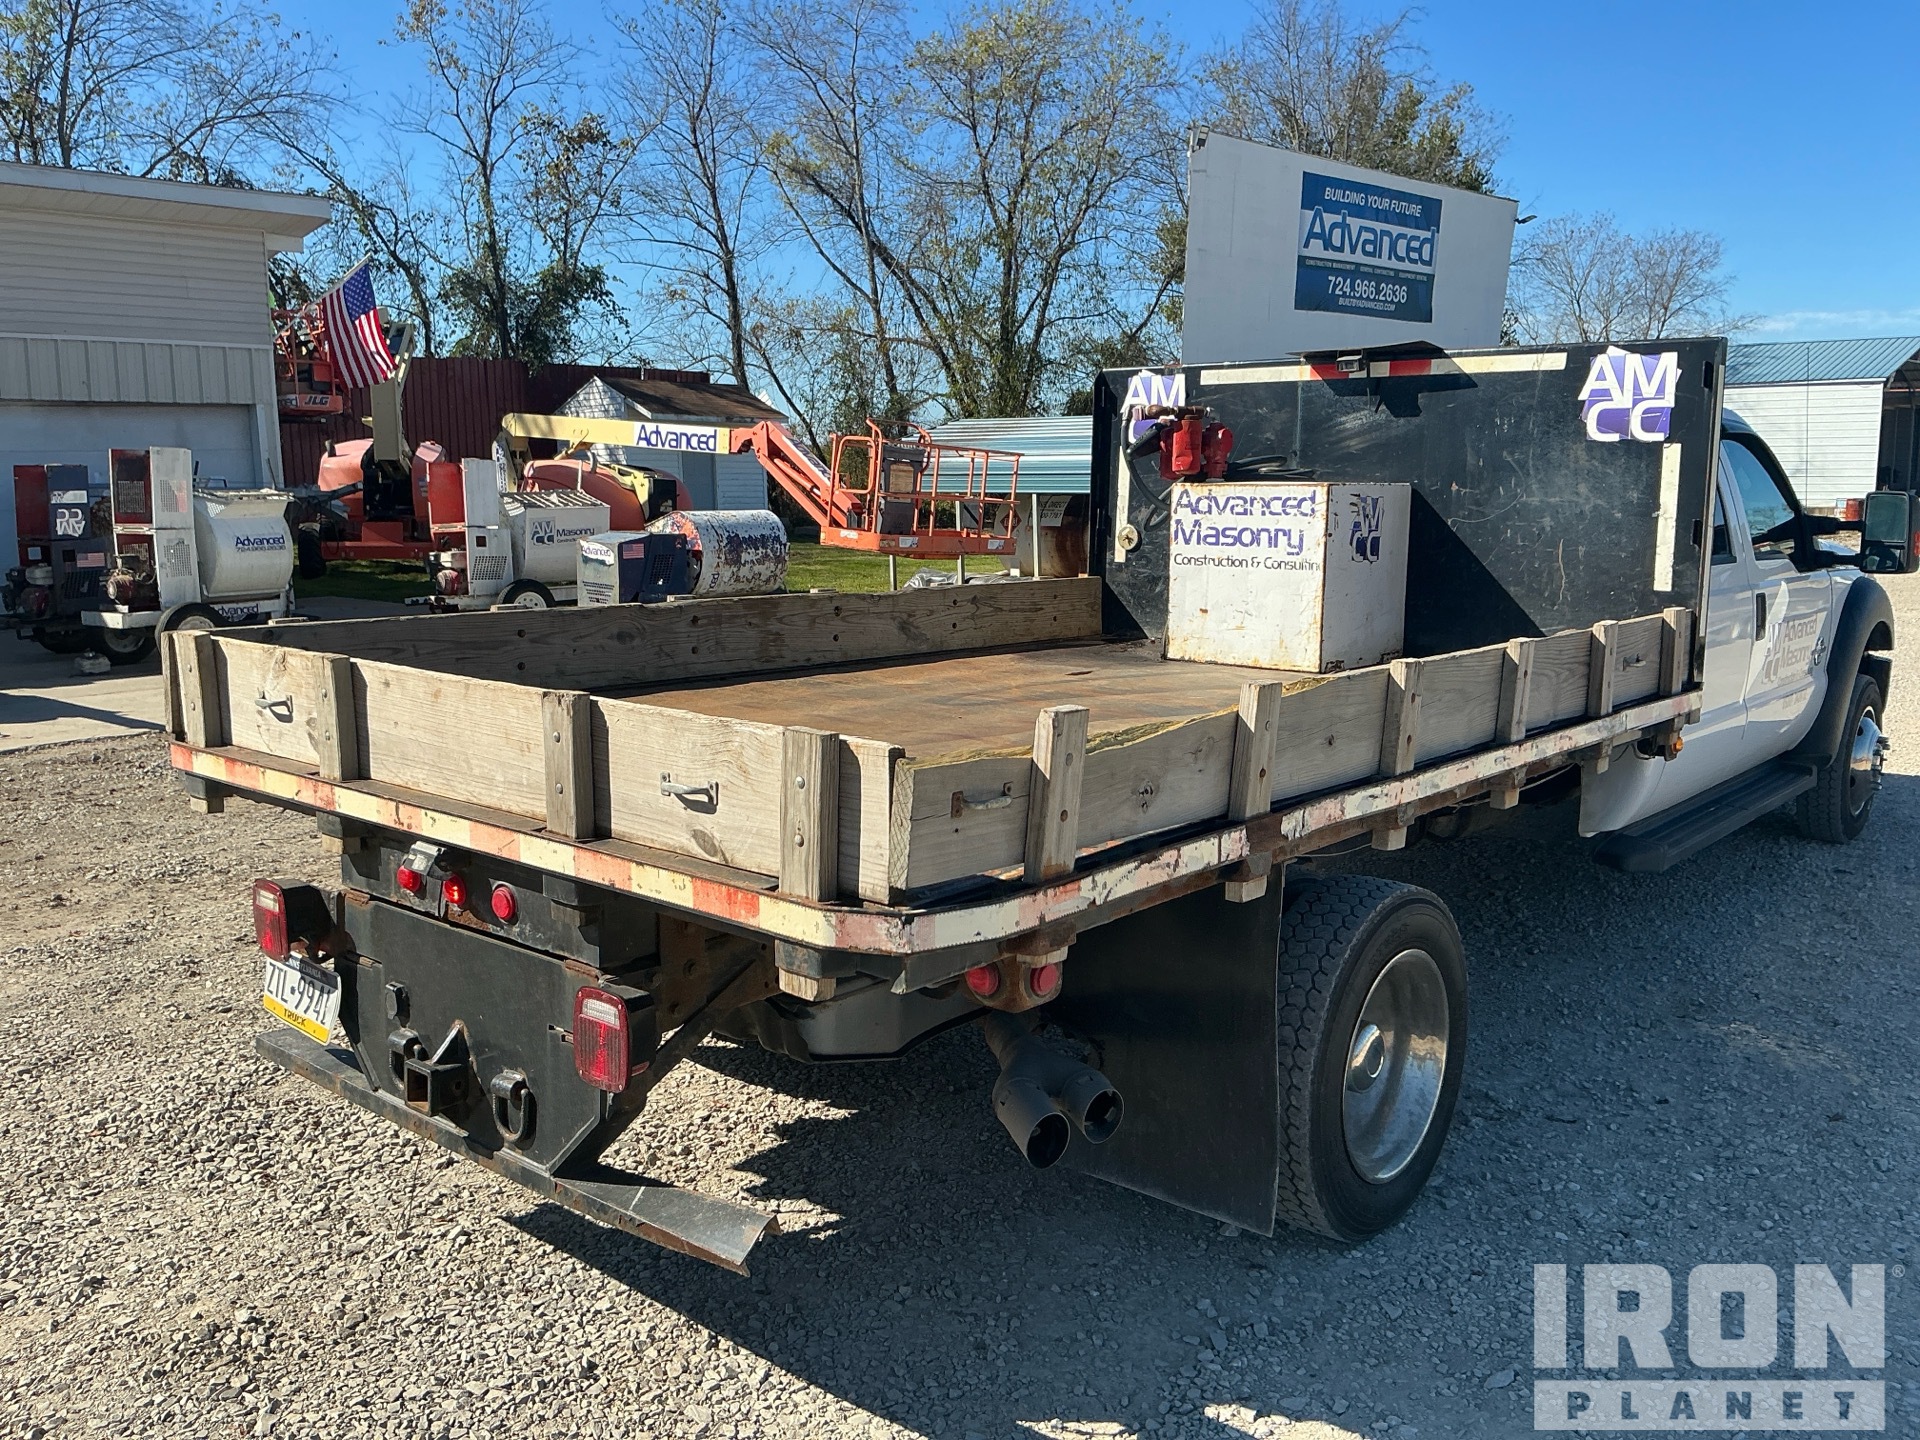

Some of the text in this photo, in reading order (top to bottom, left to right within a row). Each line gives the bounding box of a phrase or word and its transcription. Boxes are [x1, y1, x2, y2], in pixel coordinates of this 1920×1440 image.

[1324, 187, 1422, 217] BUILDING YOUR FUTURE
[1302, 206, 1436, 267] Advanced
[1328, 275, 1407, 304] 724.966.2636
[304, 395, 330, 406] JLG
[636, 424, 718, 451] Advanced
[1173, 488, 1316, 517] Advanced
[235, 534, 285, 546] Advanced
[556, 528, 594, 537] Masonry
[1173, 519, 1305, 556] Masonry
[1174, 553, 1248, 568] Construction
[217, 603, 259, 615] dvanced
[267, 961, 288, 1003] ZTL
[284, 1008, 307, 1027] TRUCK
